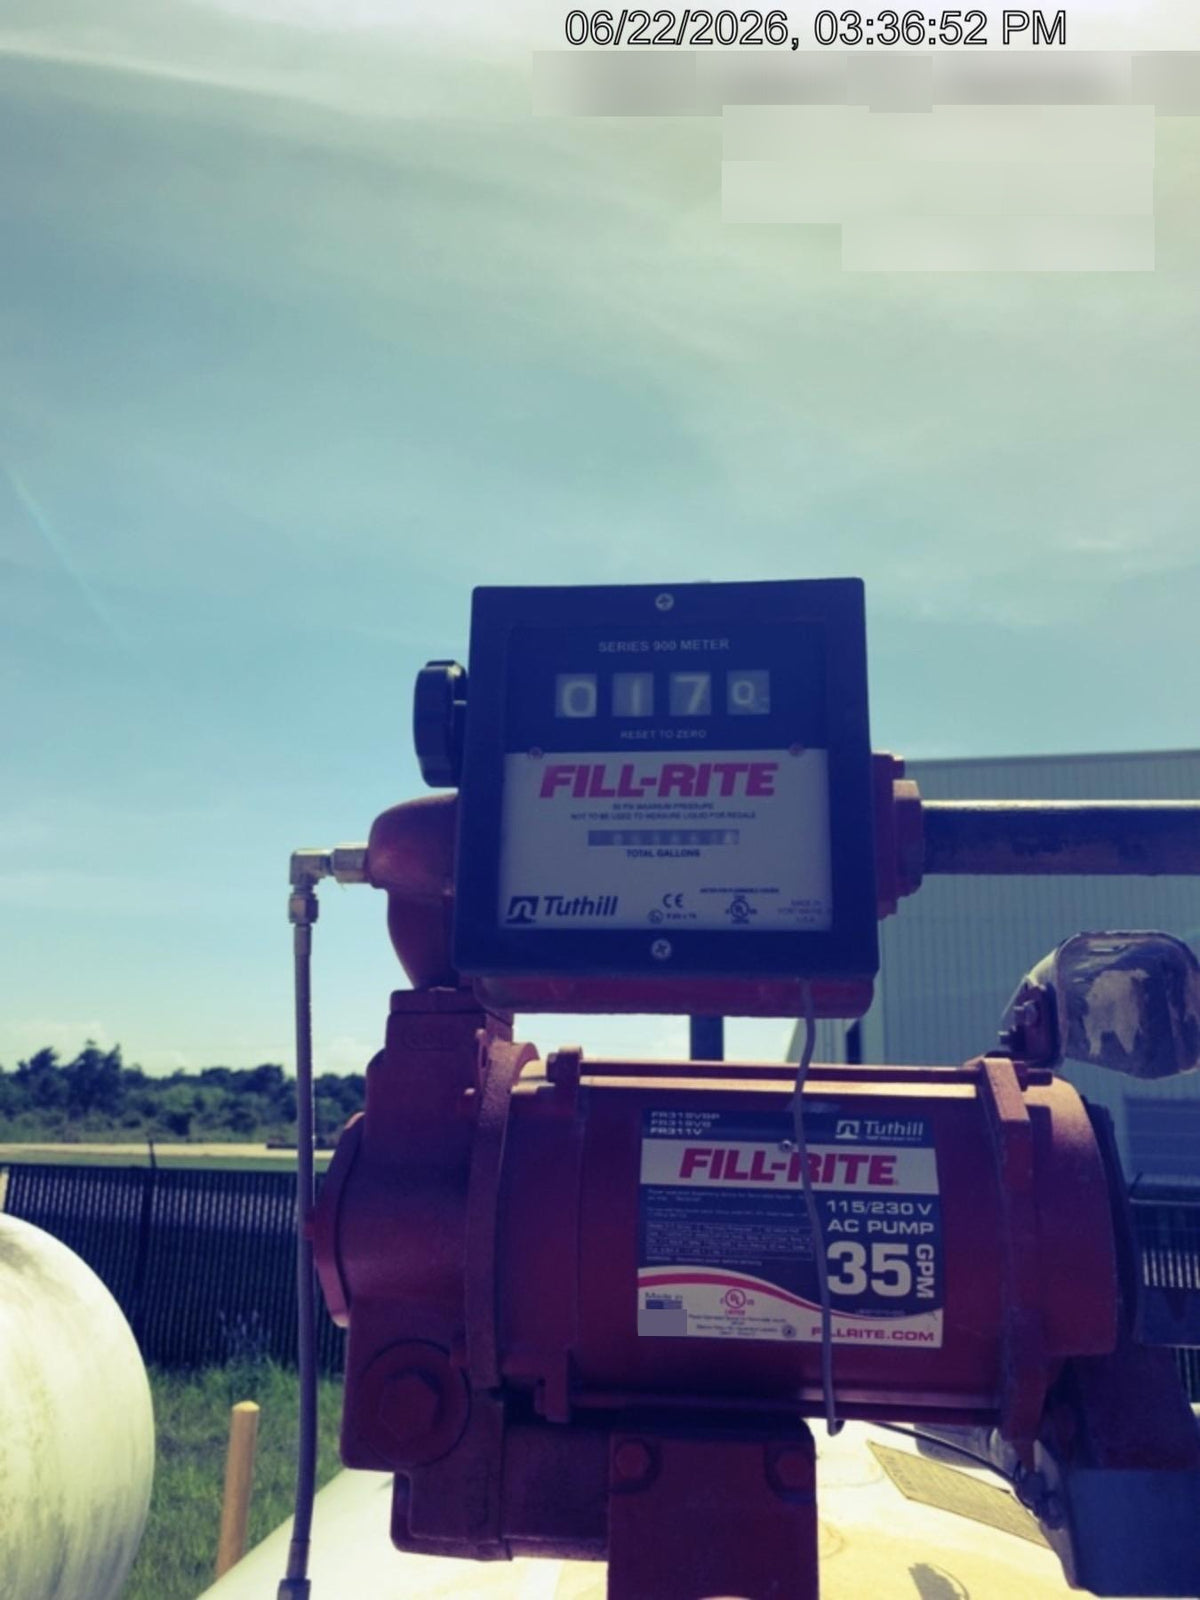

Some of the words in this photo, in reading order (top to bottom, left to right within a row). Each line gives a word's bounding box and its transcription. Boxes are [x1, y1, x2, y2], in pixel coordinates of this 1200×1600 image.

[598, 640, 650, 653] SERIES
[653, 639, 677, 652] 900
[679, 638, 730, 652] METER
[620, 729, 657, 740] RESET
[659, 729, 674, 739] TO
[676, 728, 707, 739] ZERO
[539, 763, 779, 799] FILL-RITE
[626, 848, 653, 858] TOTAL
[656, 848, 701, 858] GALLONS
[543, 896, 619, 917] Tuthill
[864, 1120, 924, 1137] Tuthill
[679, 1148, 897, 1186] FILL-RITE
[826, 1199, 914, 1217] 115/230
[917, 1202, 933, 1216] V
[827, 1219, 860, 1233] AC
[867, 1220, 935, 1235] PUMP
[826, 1240, 913, 1298] 35
[915, 1243, 935, 1299] GPM
[811, 1326, 935, 1342] FLRITE.COM
